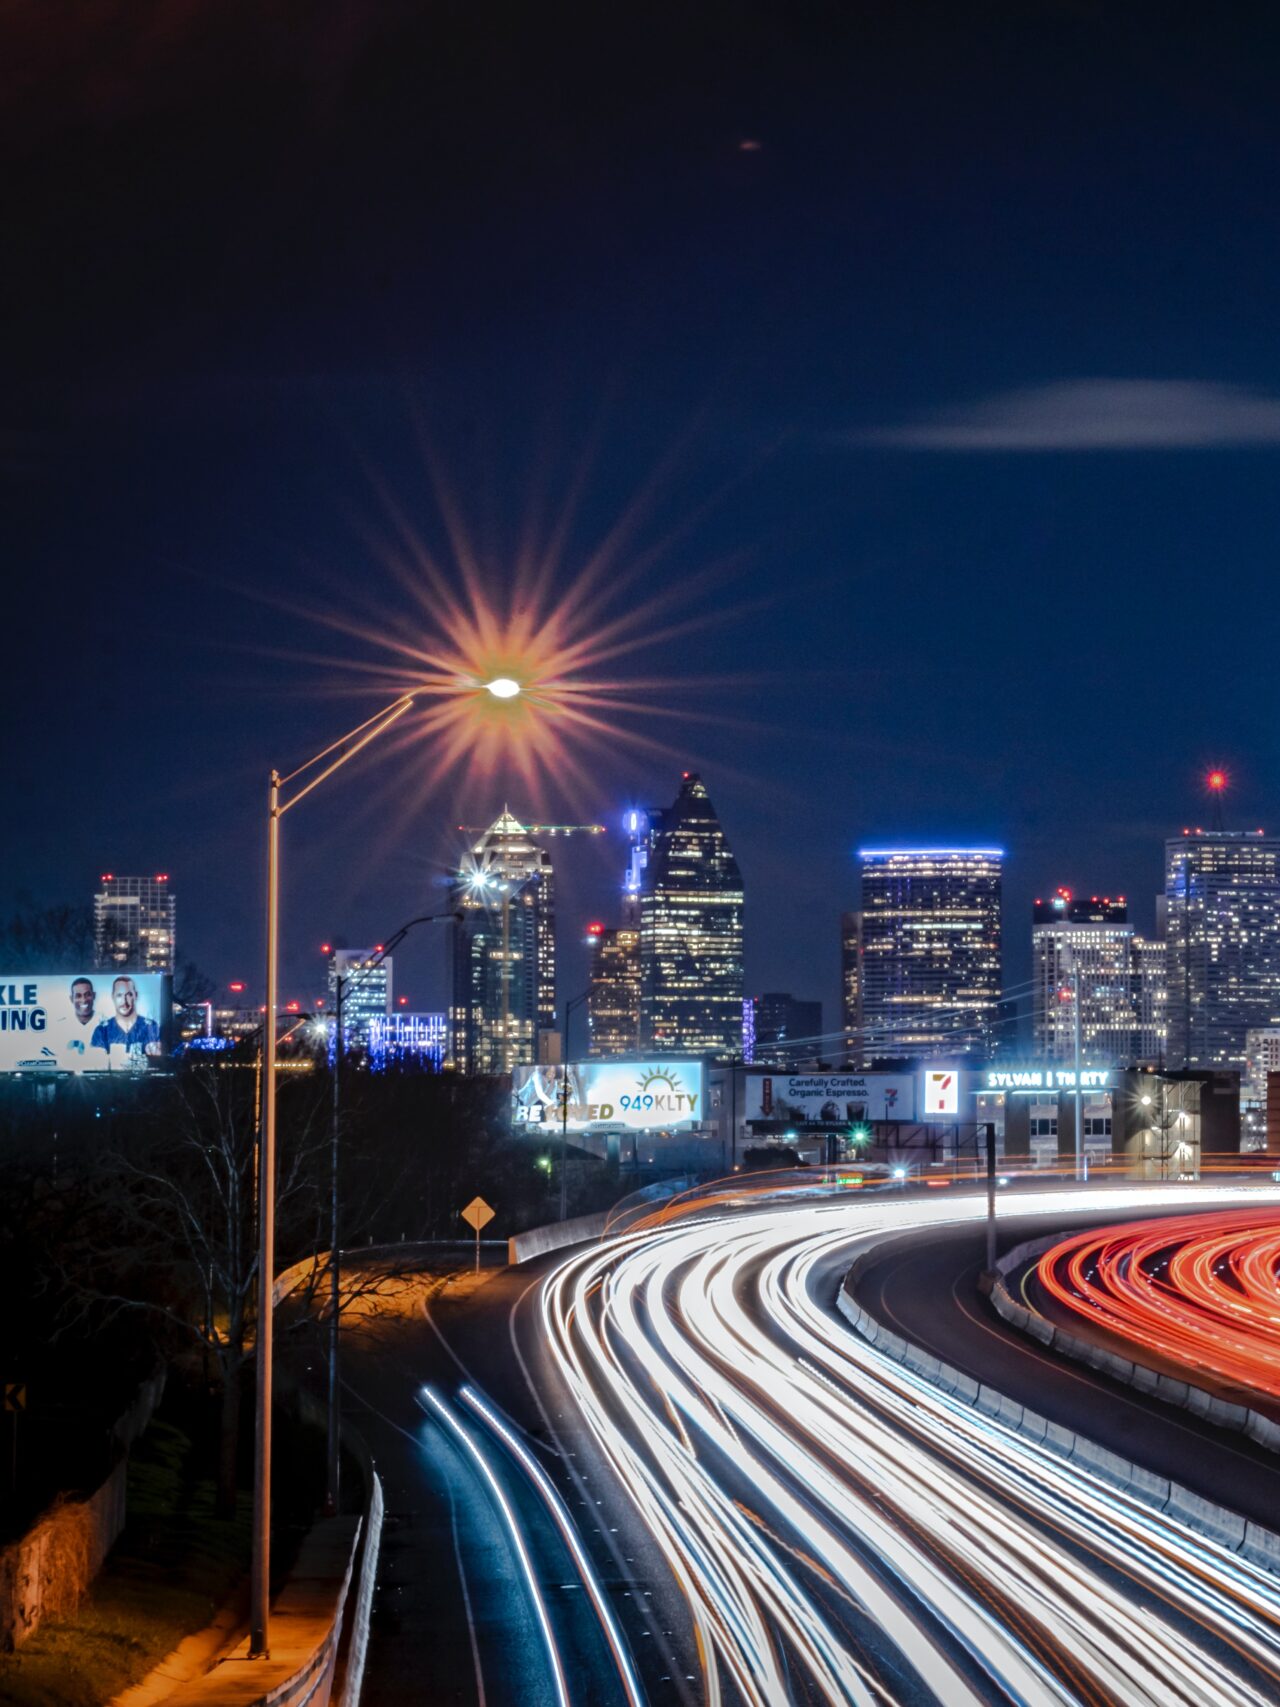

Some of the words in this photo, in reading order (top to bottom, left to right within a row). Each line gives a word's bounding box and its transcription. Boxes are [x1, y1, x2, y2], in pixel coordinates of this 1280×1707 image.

[788, 1078, 829, 1088] Carefully
[830, 1078, 867, 1087] Crafted.
[988, 1072, 1042, 1087] SYLVAN
[1056, 1071, 1109, 1086] THRTY
[788, 1089, 824, 1098] Organic
[826, 1089, 869, 1098] Espresso.
